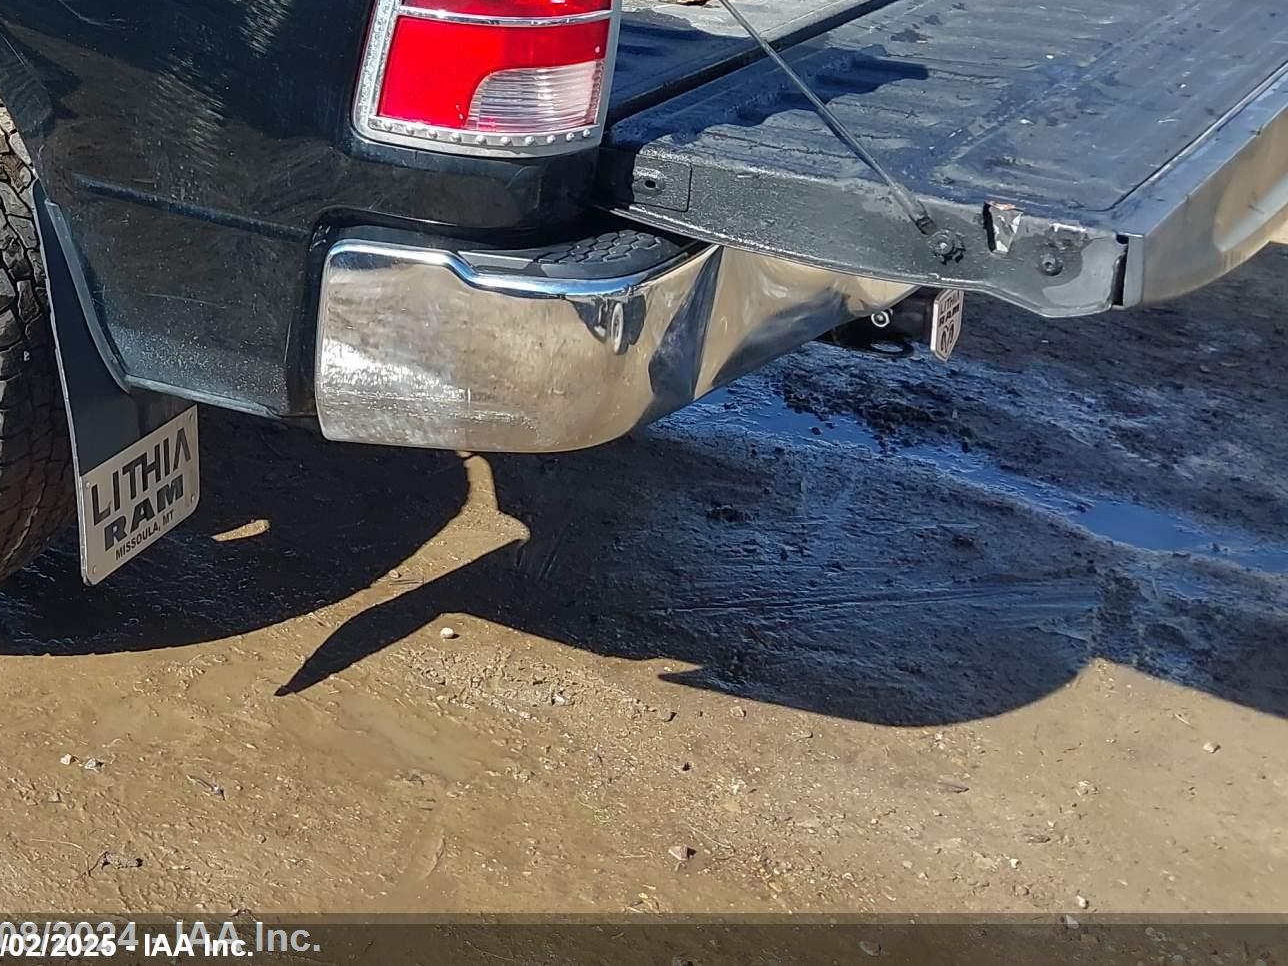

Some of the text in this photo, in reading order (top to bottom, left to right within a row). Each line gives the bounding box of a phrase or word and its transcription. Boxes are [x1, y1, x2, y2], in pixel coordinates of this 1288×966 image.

[91, 427, 191, 526] LITHIA
[104, 474, 184, 552] RAM
[115, 508, 175, 561] MISSOULA, MT
